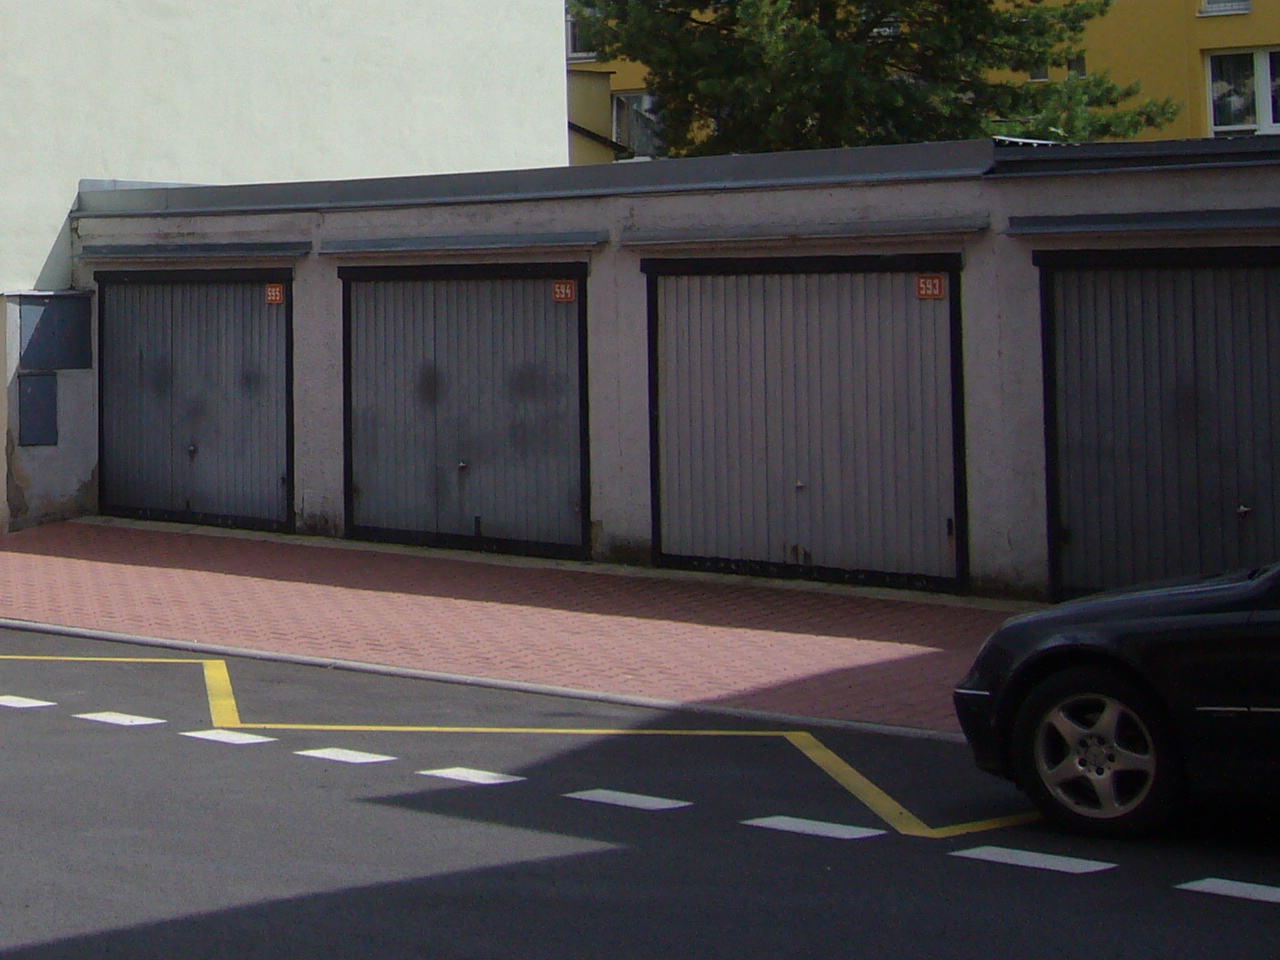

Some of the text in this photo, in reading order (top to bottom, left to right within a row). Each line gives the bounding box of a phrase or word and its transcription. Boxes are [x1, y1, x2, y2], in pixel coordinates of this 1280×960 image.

[268, 287, 280, 300] 595
[555, 284, 571, 298] 594
[920, 279, 939, 295] 593
